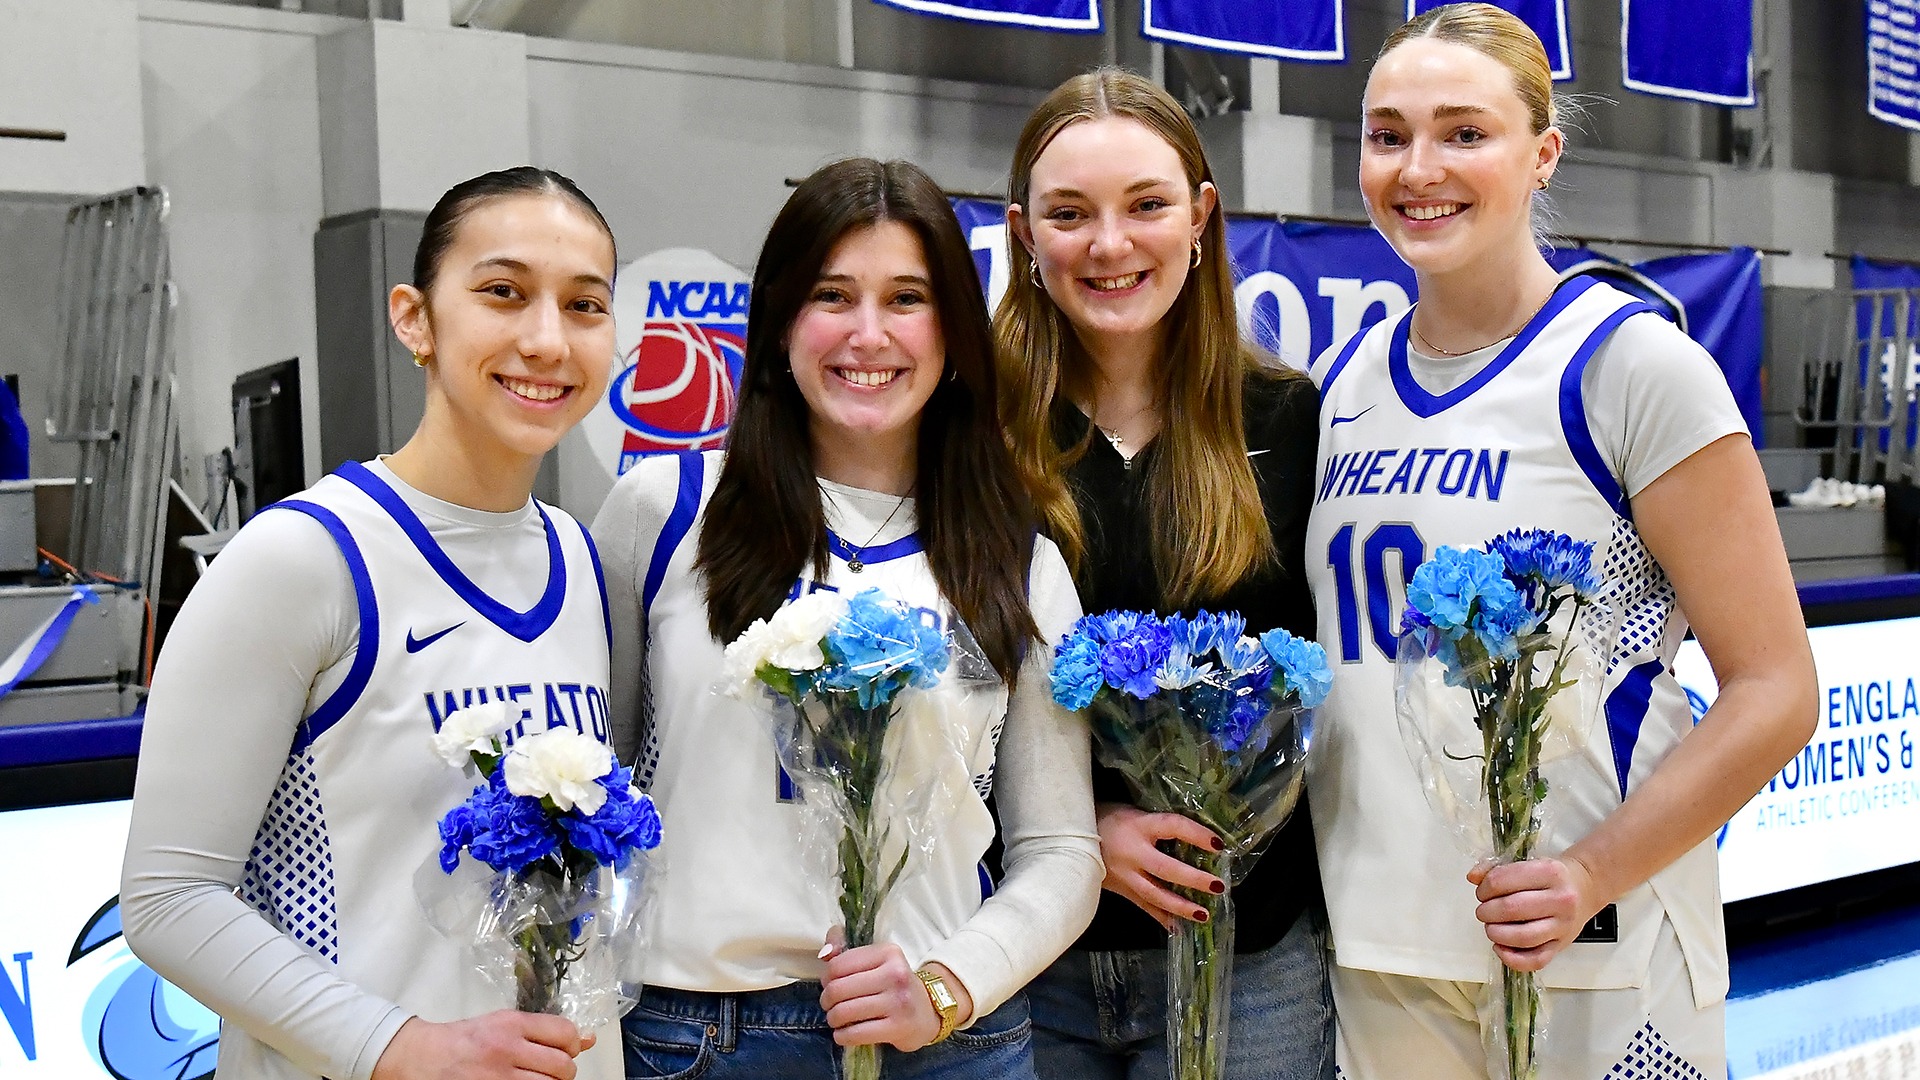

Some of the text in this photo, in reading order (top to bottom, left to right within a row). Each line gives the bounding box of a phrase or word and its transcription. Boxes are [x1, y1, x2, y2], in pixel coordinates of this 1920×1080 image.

[646, 281, 751, 318] NCAA
[1316, 448, 1511, 505] WHEATON
[1326, 520, 1427, 665] 10
[1757, 730, 1913, 794] OMEN'S &
[1756, 792, 1833, 832] ATHLETIC
[1594, 916, 1603, 930] L
